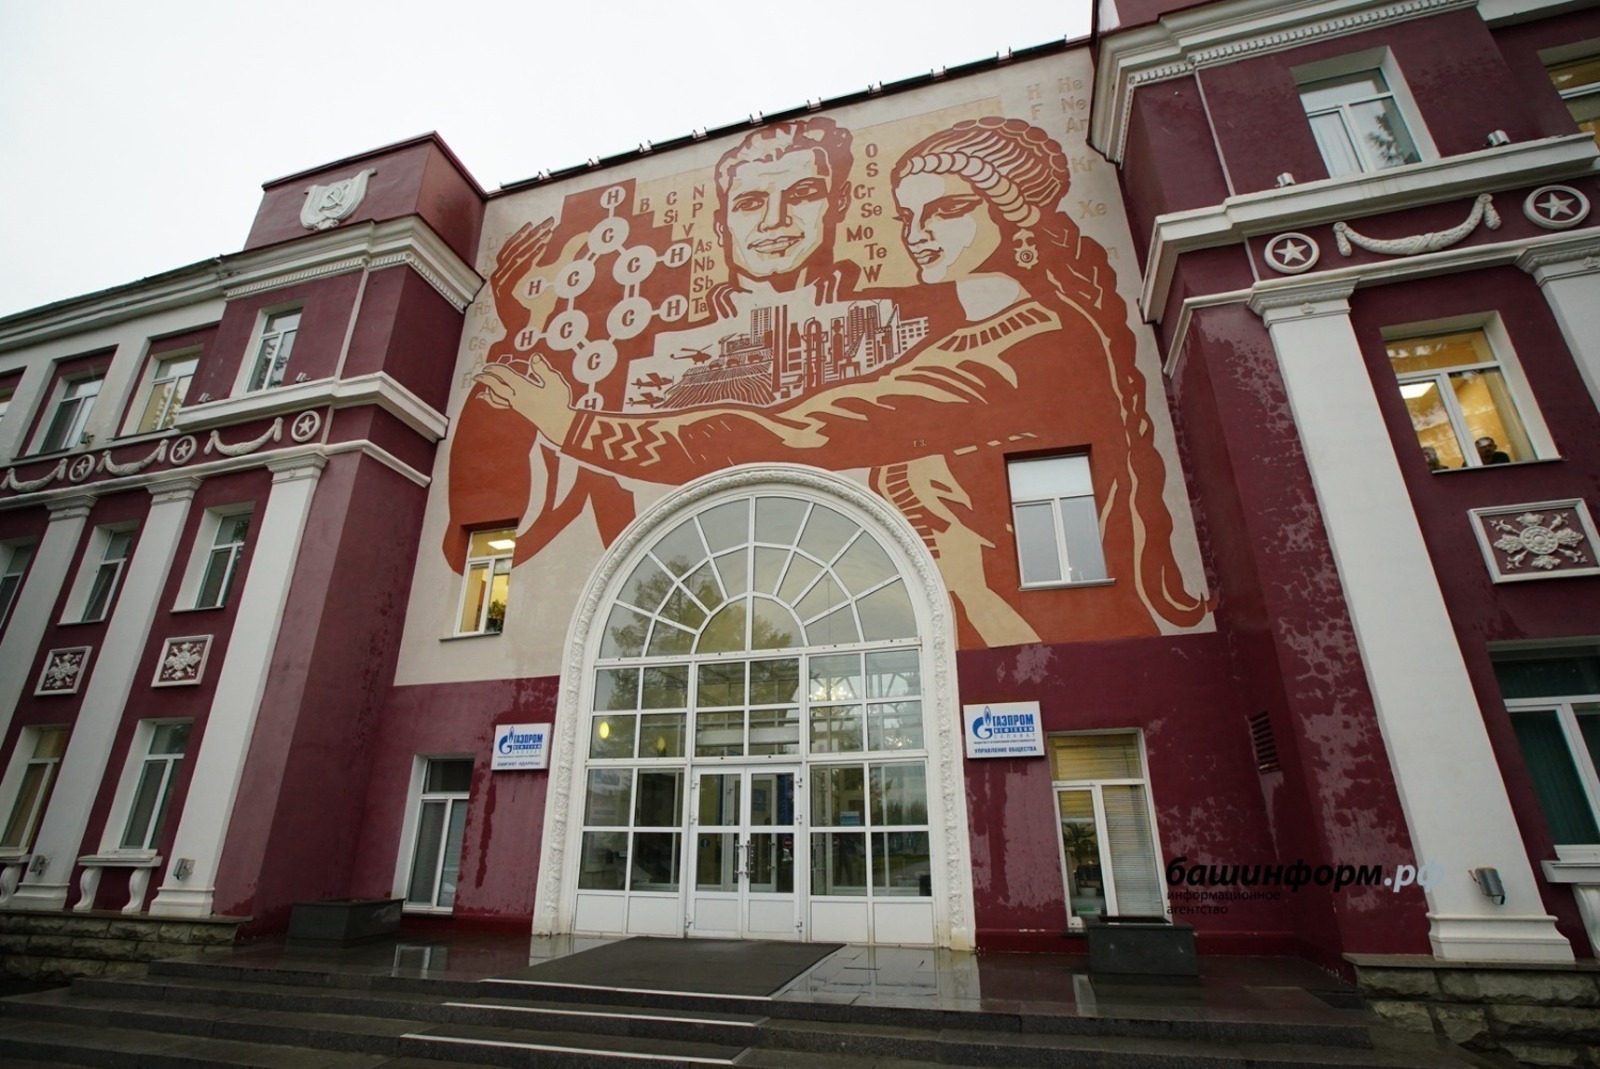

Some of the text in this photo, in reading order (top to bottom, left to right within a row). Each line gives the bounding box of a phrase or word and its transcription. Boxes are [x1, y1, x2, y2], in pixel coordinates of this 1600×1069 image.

[866, 162, 879, 177] S
[607, 189, 620, 205] H
[666, 191, 677, 206] C
[693, 184, 705, 200] N
[853, 184, 875, 200] Cr
[639, 198, 650, 212] B
[692, 203, 703, 218] P
[860, 202, 883, 218] Se
[664, 209, 678, 224] Si
[682, 223, 695, 238] V
[695, 238, 713, 254] As
[864, 243, 888, 260] Te
[670, 248, 684, 263] H
[693, 258, 715, 274] Nb
[863, 264, 883, 283] W
[528, 280, 542, 296] H
[693, 276, 714, 292] Sb
[666, 302, 681, 317] H
[692, 299, 707, 314] Ta
[520, 332, 534, 347] H
[993, 714, 1034, 726] ГАЗПРОМ
[513, 734, 543, 743] ГАЗПРОМ
